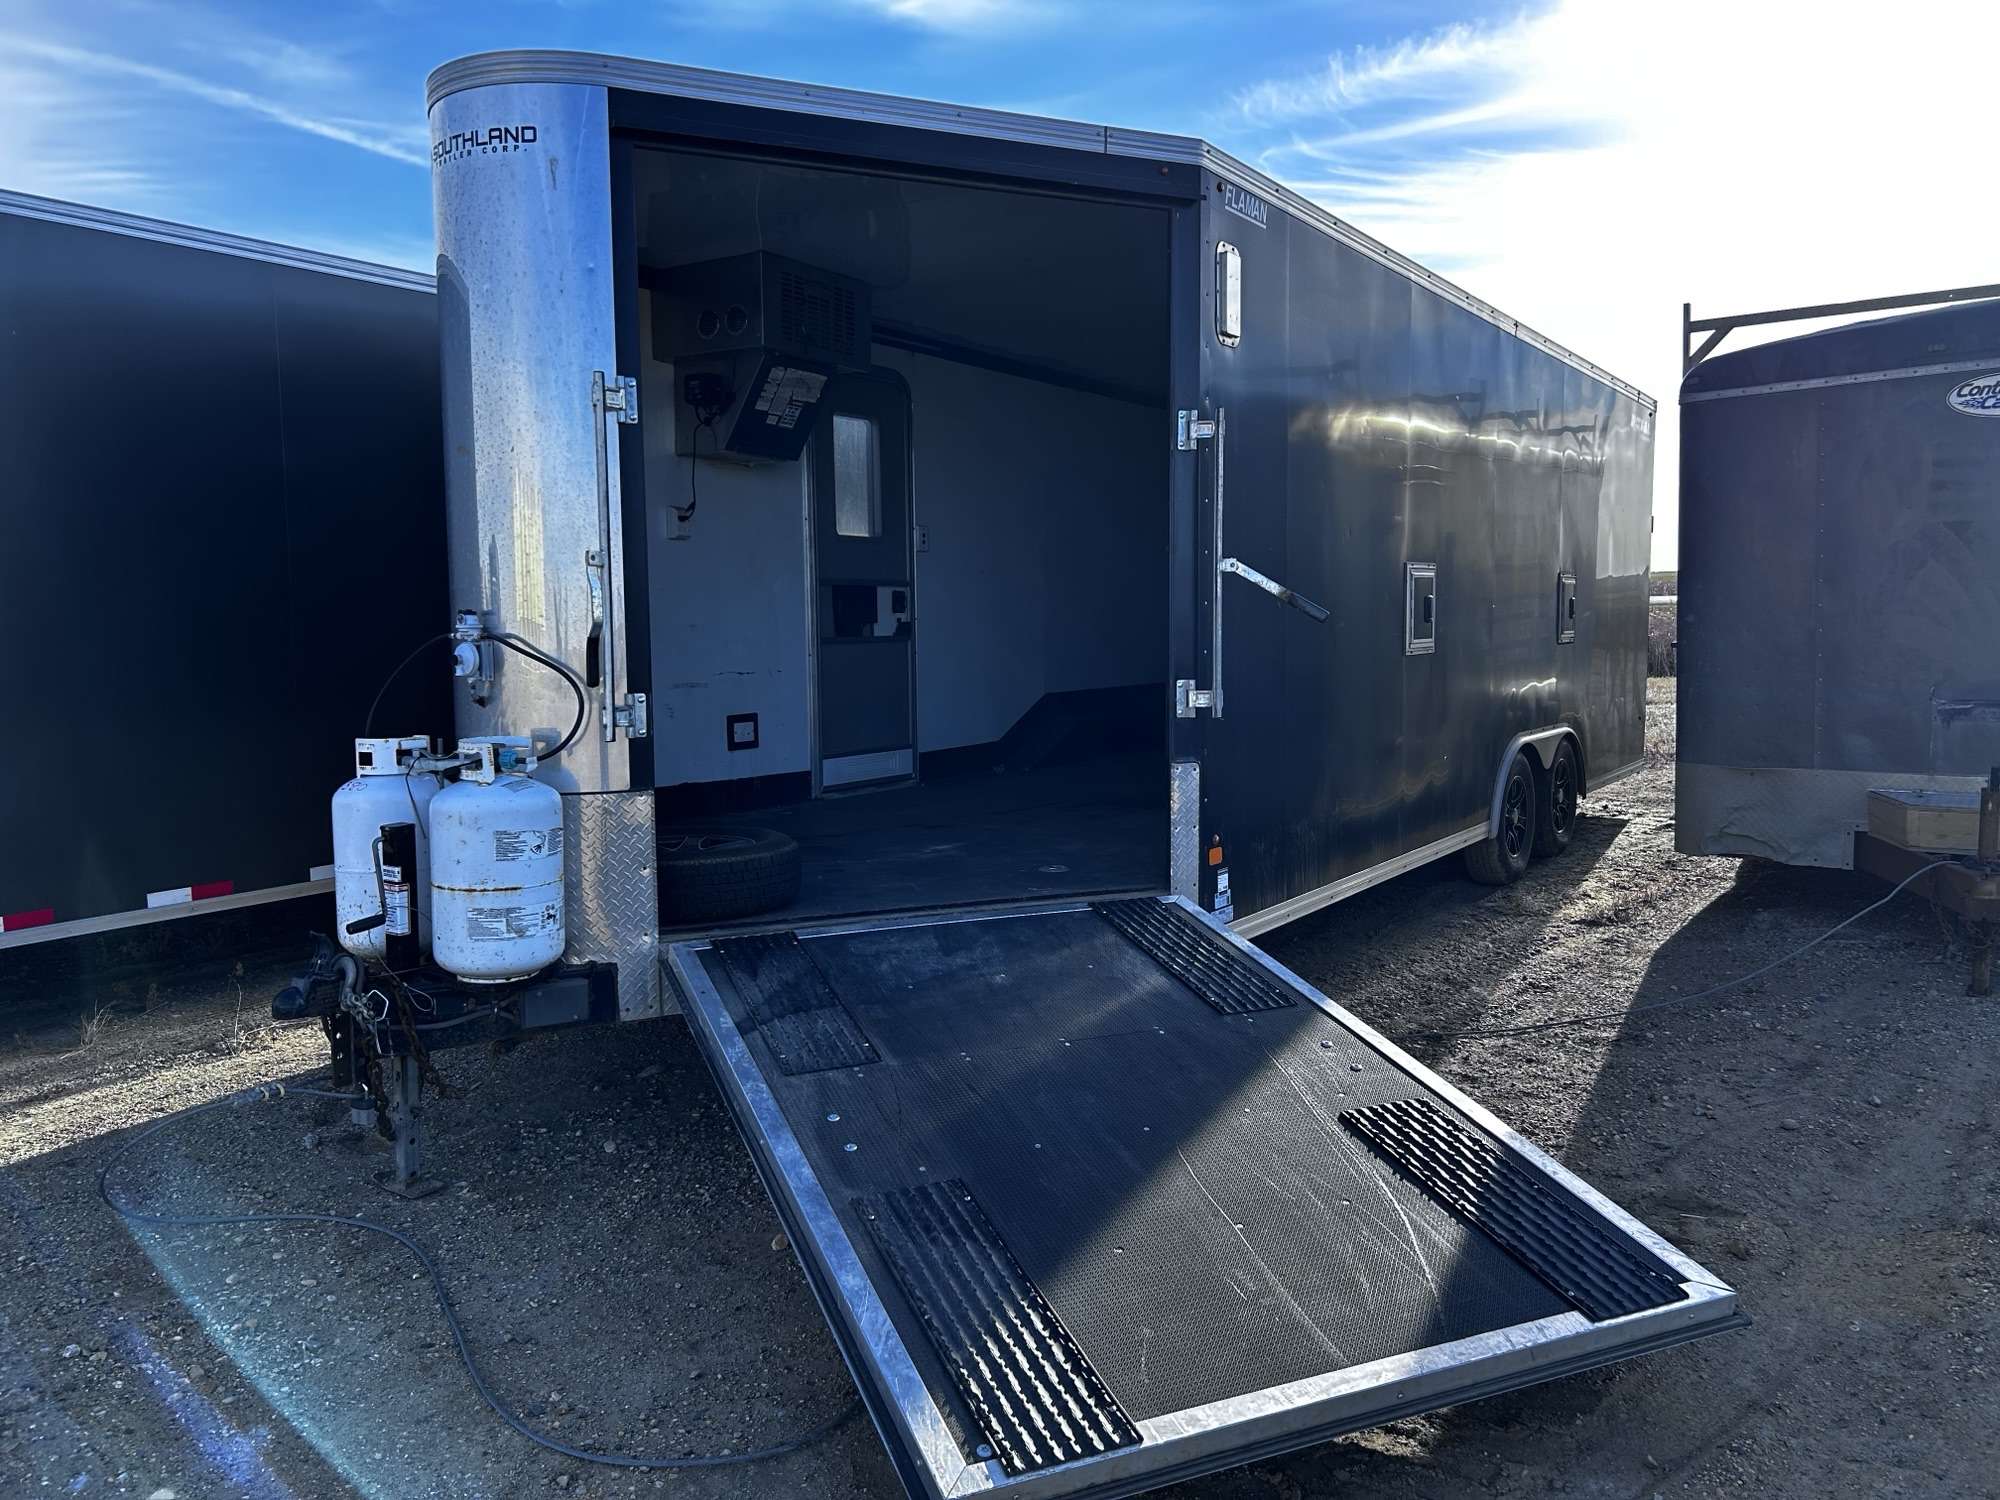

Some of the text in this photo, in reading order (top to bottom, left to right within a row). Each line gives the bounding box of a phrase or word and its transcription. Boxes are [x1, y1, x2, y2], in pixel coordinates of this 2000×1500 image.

[433, 126, 537, 161] SOUTHLAND
[482, 145, 527, 154] CORP.
[1225, 184, 1267, 223] FLAMAN
